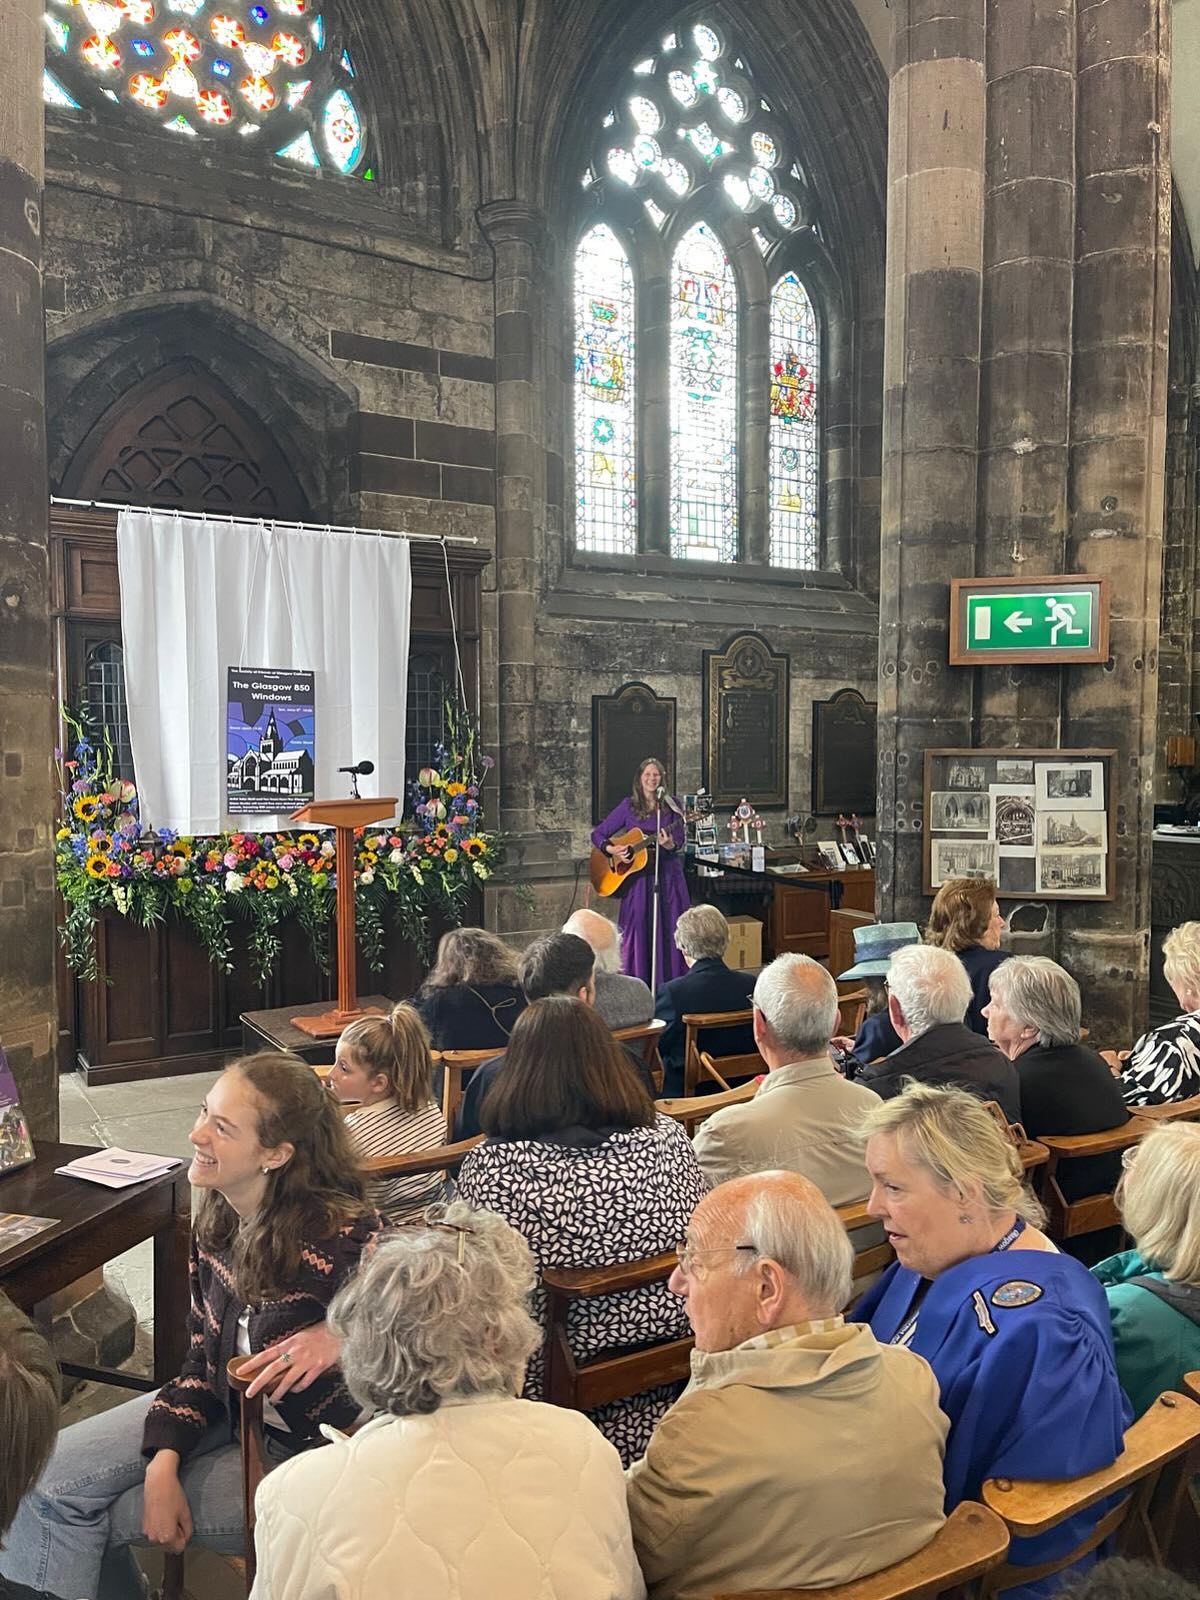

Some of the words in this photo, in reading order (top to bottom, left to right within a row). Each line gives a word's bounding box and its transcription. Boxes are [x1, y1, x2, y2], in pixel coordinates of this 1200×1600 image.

[232, 681, 249, 689] The
[251, 682, 292, 692] Glasgow
[294, 684, 310, 692] 850
[251, 692, 292, 701] Windows
